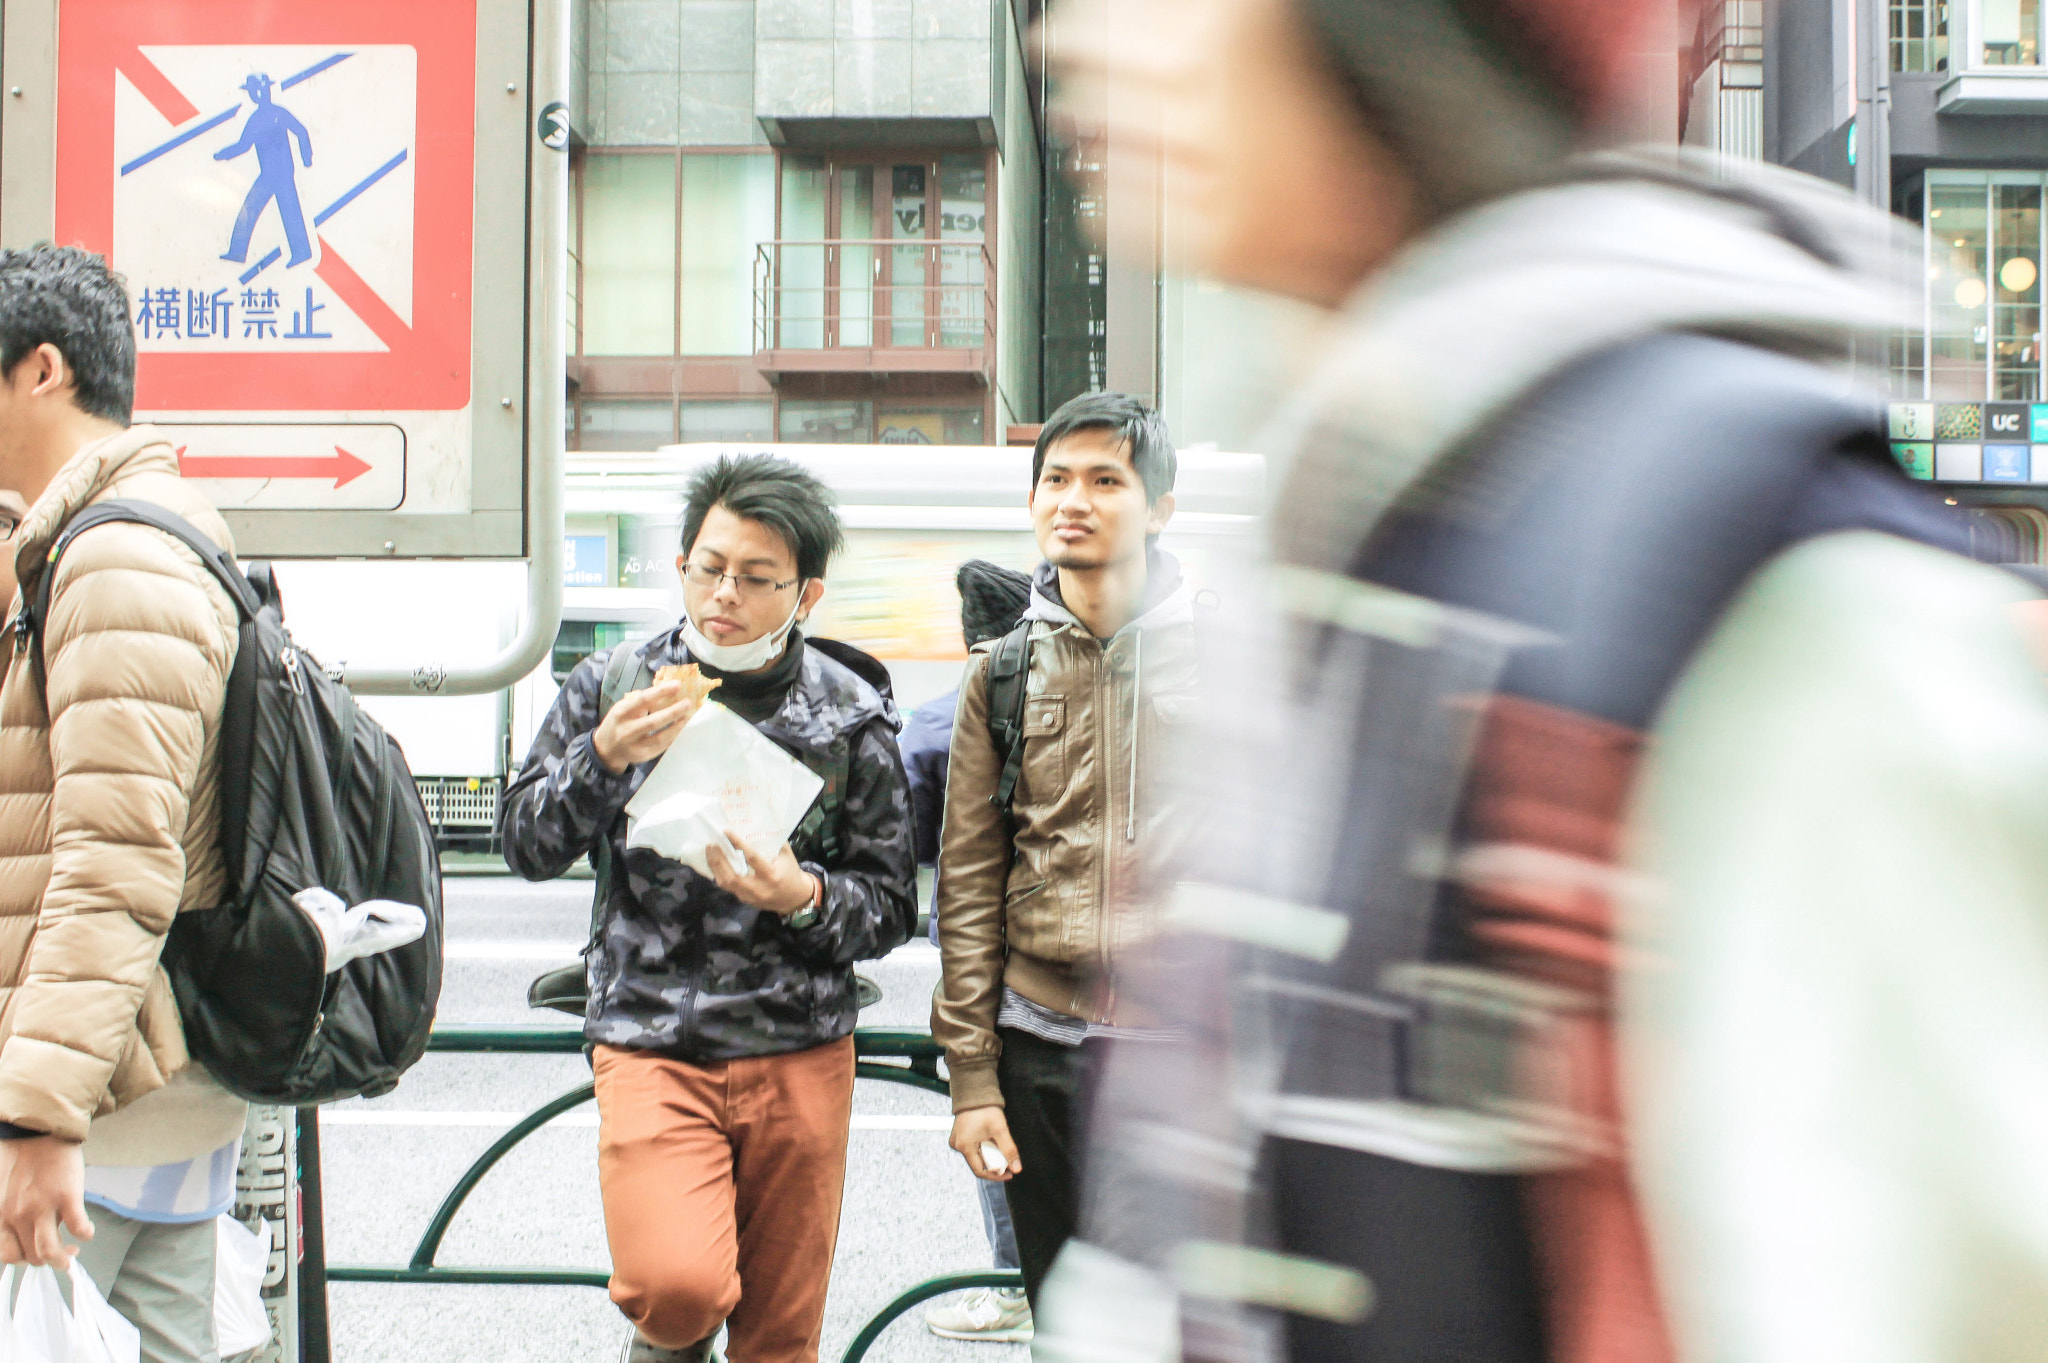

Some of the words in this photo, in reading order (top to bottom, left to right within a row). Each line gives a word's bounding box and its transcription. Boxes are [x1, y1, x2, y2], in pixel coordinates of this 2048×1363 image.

[136, 287, 333, 339] 横断禁止
[1992, 414, 2020, 432] UC
